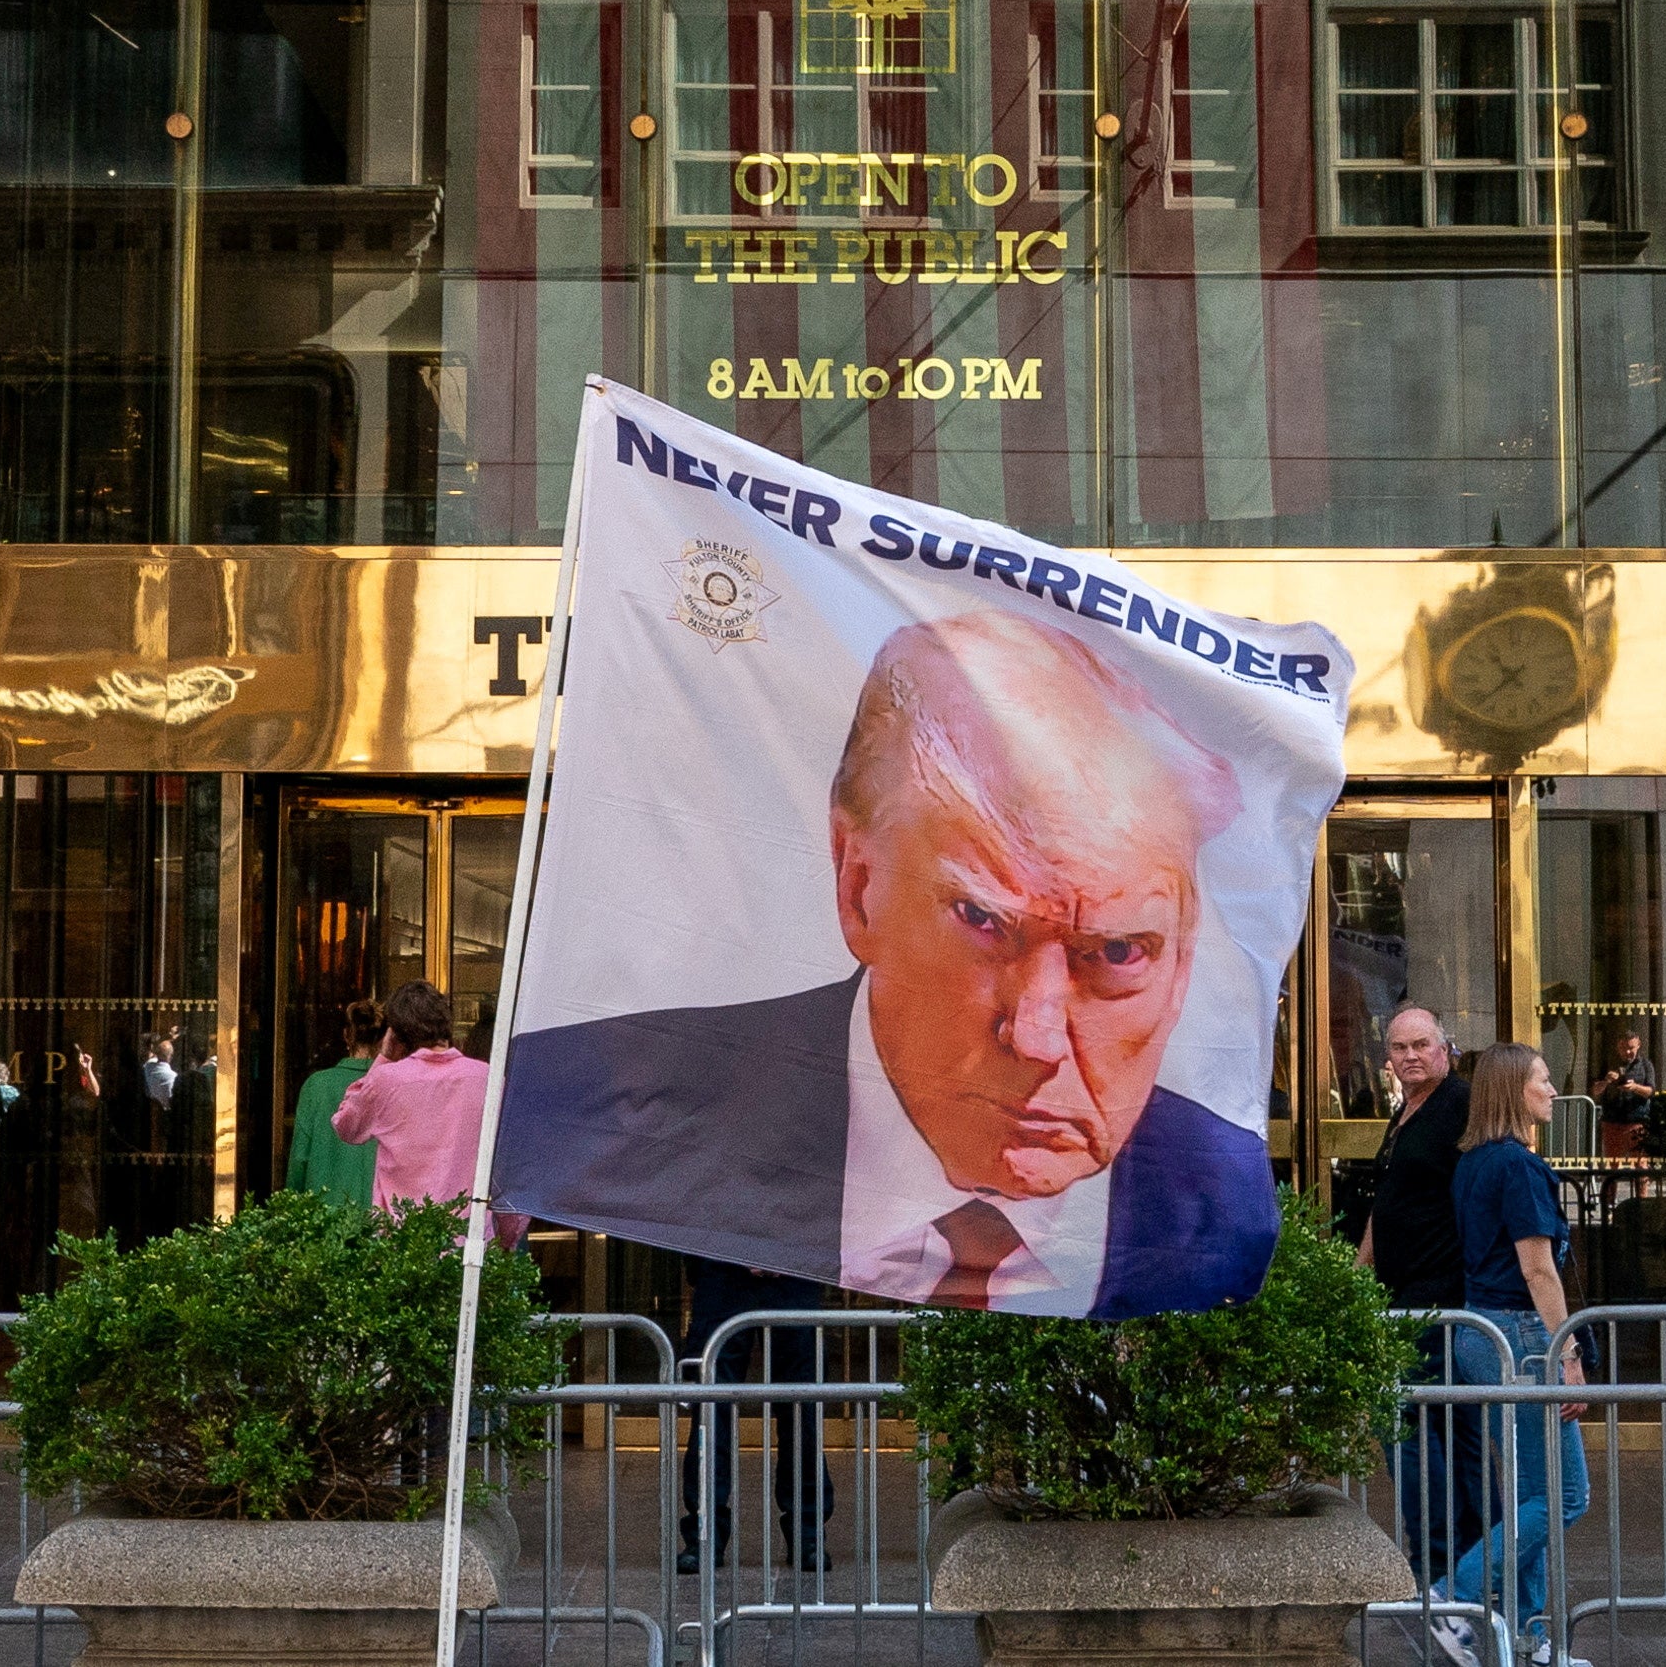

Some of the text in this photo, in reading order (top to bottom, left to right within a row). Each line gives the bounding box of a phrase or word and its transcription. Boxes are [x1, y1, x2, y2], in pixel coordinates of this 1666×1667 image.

[735, 153, 1017, 206] OPEN TO
[685, 231, 1067, 285] THE PUBLIC
[707, 358, 1042, 400] 8 AM to 10 PM
[615, 416, 1331, 694] NEVER SURRENDER
[689, 552, 719, 569] FULTON
[721, 555, 753, 582] COUNTY
[696, 540, 748, 562] SHERIFF
[687, 617, 720, 639] PATRICK
[724, 608, 753, 627] OFFICE
